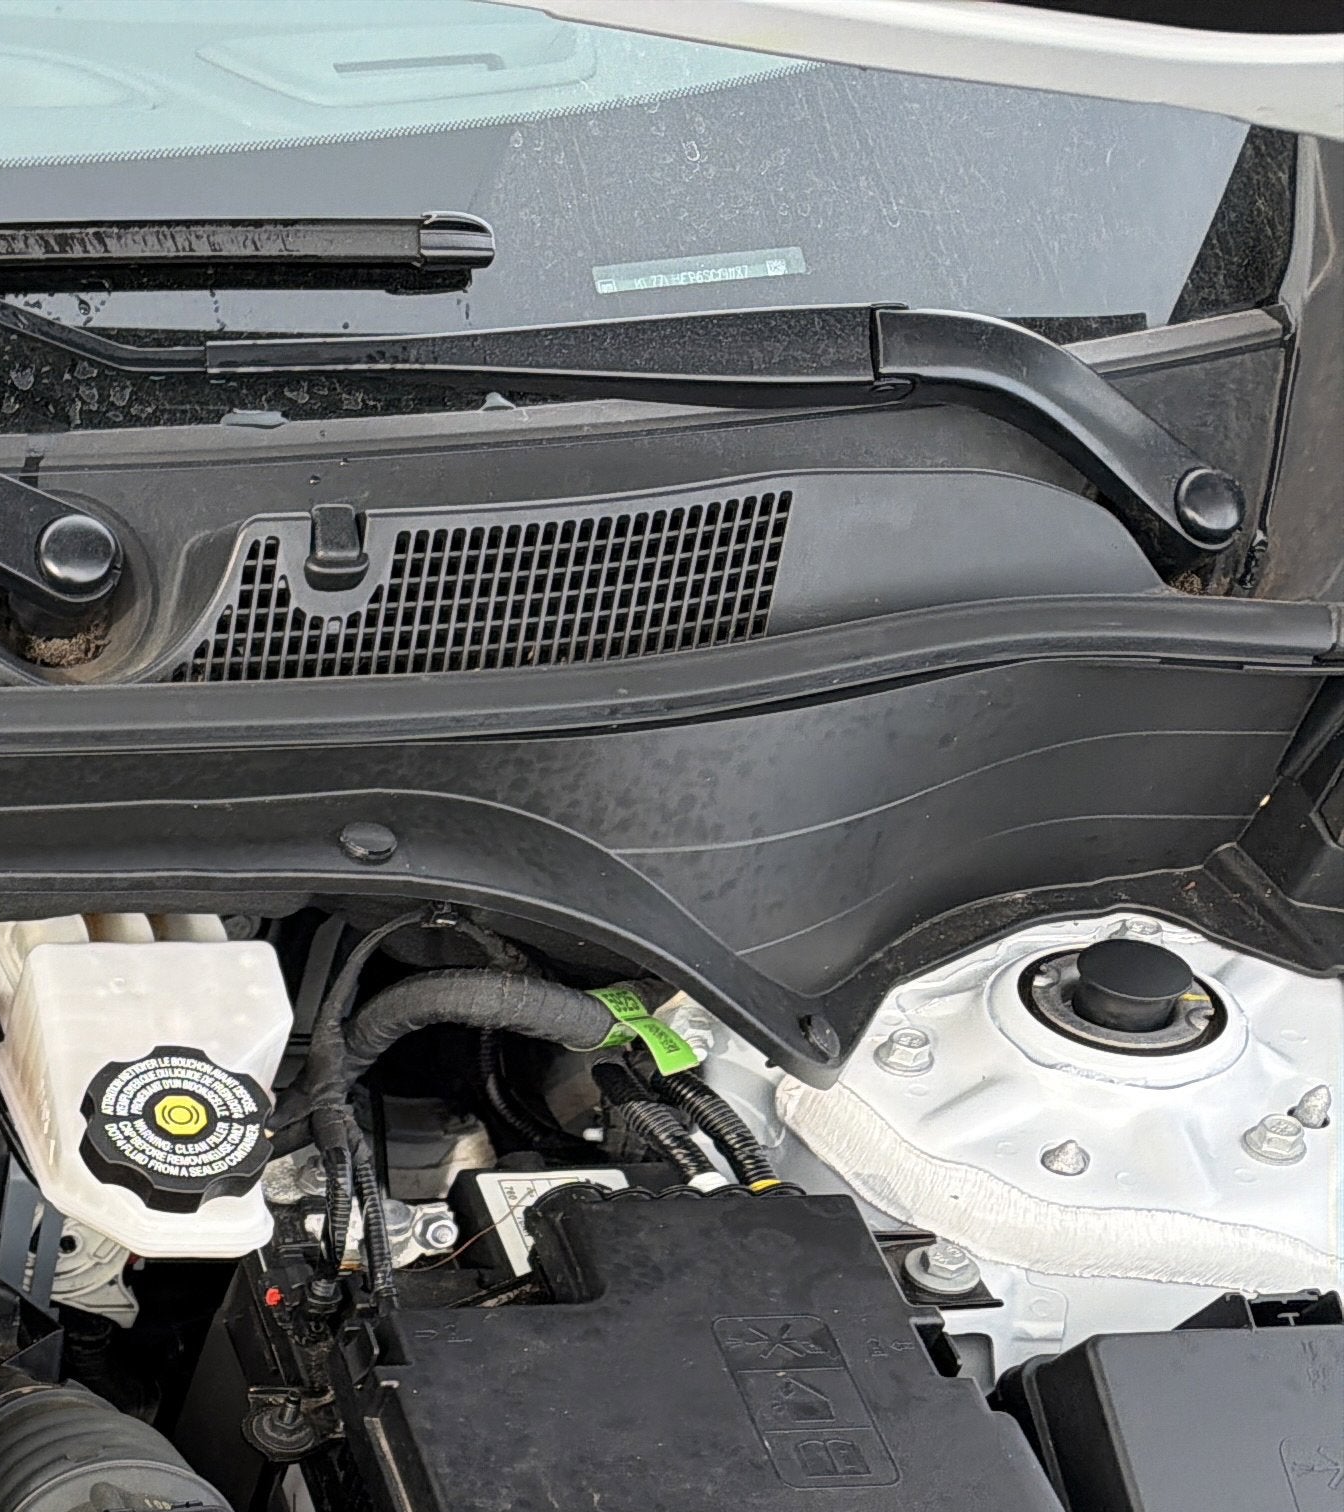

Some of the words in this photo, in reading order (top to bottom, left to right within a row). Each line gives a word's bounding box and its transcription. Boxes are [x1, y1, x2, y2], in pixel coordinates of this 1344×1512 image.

[155, 1068, 169, 1079] DU
[200, 1072, 217, 1086] DE
[157, 1057, 171, 1067] LE
[170, 1057, 214, 1074] BOUCHON
[210, 1064, 240, 1088] AVANT
[129, 1136, 168, 1162] BEFORE
[227, 1122, 245, 1144] ONLY
[175, 1141, 210, 1154] CLEAN
[205, 1122, 230, 1147] FILLER
[148, 1159, 179, 1176] FROM
[189, 1160, 229, 1177] SEALED
